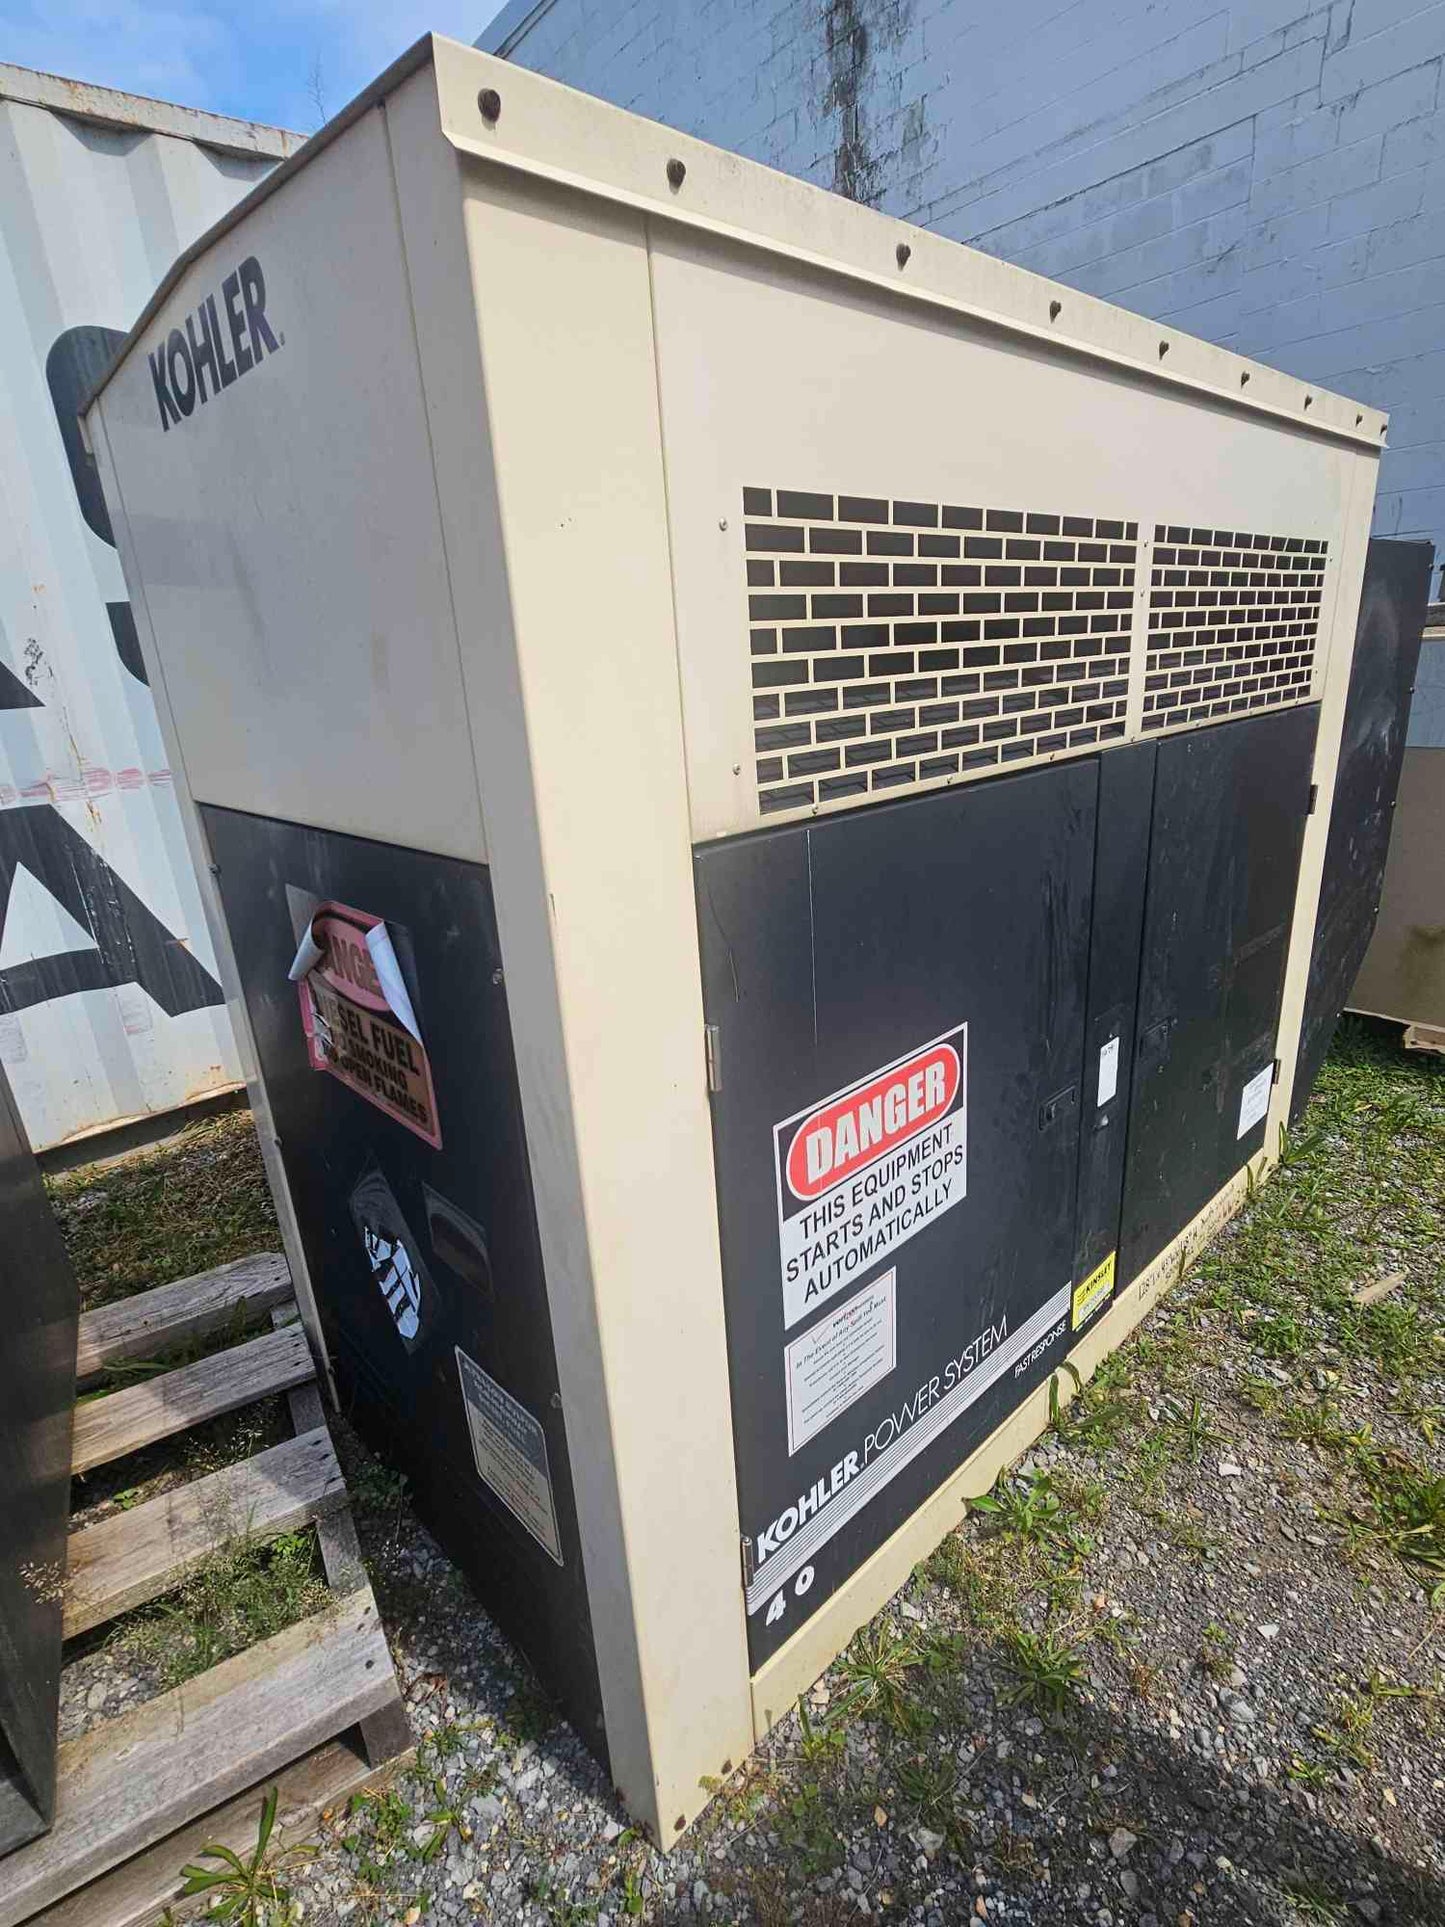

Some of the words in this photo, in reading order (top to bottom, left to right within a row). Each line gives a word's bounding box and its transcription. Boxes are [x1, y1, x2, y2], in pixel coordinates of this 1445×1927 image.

[148, 256, 280, 432] KOHLER
[371, 1020, 420, 1076] FUEL
[800, 1194, 845, 1240] THIS
[852, 1123, 953, 1207] EQUIPMENT
[805, 1060, 946, 1185] DANGER
[785, 1213, 864, 1283] STARTS
[868, 1184, 906, 1228] AND
[911, 1144, 963, 1196] STOPS
[804, 1178, 953, 1304] AUTOMATICALLY
[757, 1450, 862, 1563] KOHLER
[864, 1376, 941, 1464] POWER
[944, 1315, 1007, 1390] SYSTEM
